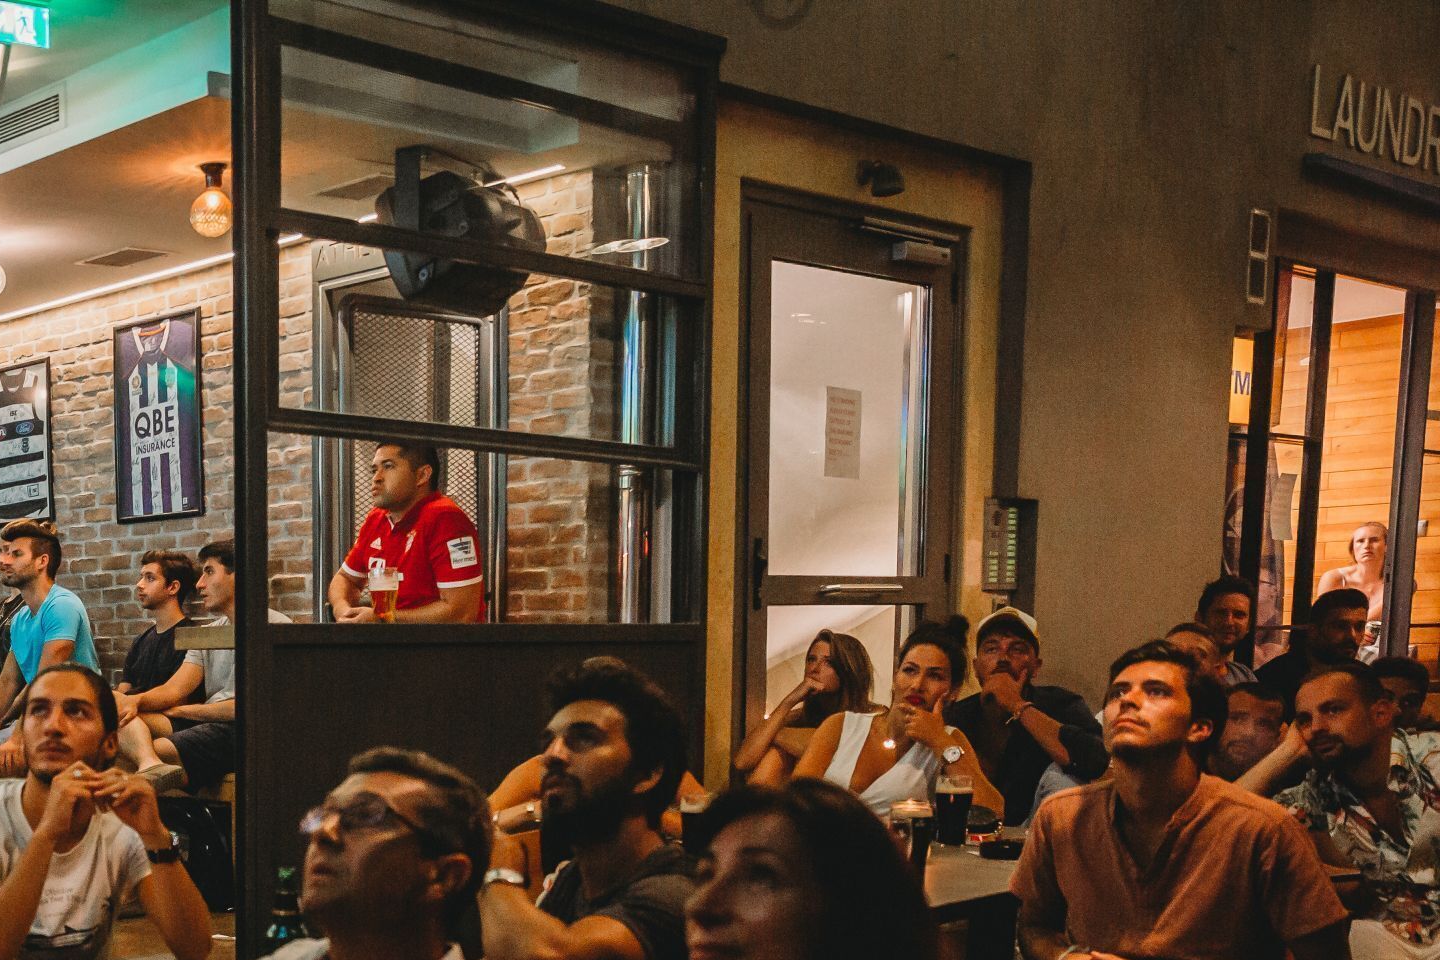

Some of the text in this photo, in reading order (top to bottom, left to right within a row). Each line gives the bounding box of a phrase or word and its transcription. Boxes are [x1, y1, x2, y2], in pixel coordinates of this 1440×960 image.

[1311, 64, 1440, 174] LAUNDR
[134, 405, 175, 439] QBE
[135, 438, 176, 456] INSURANCE
